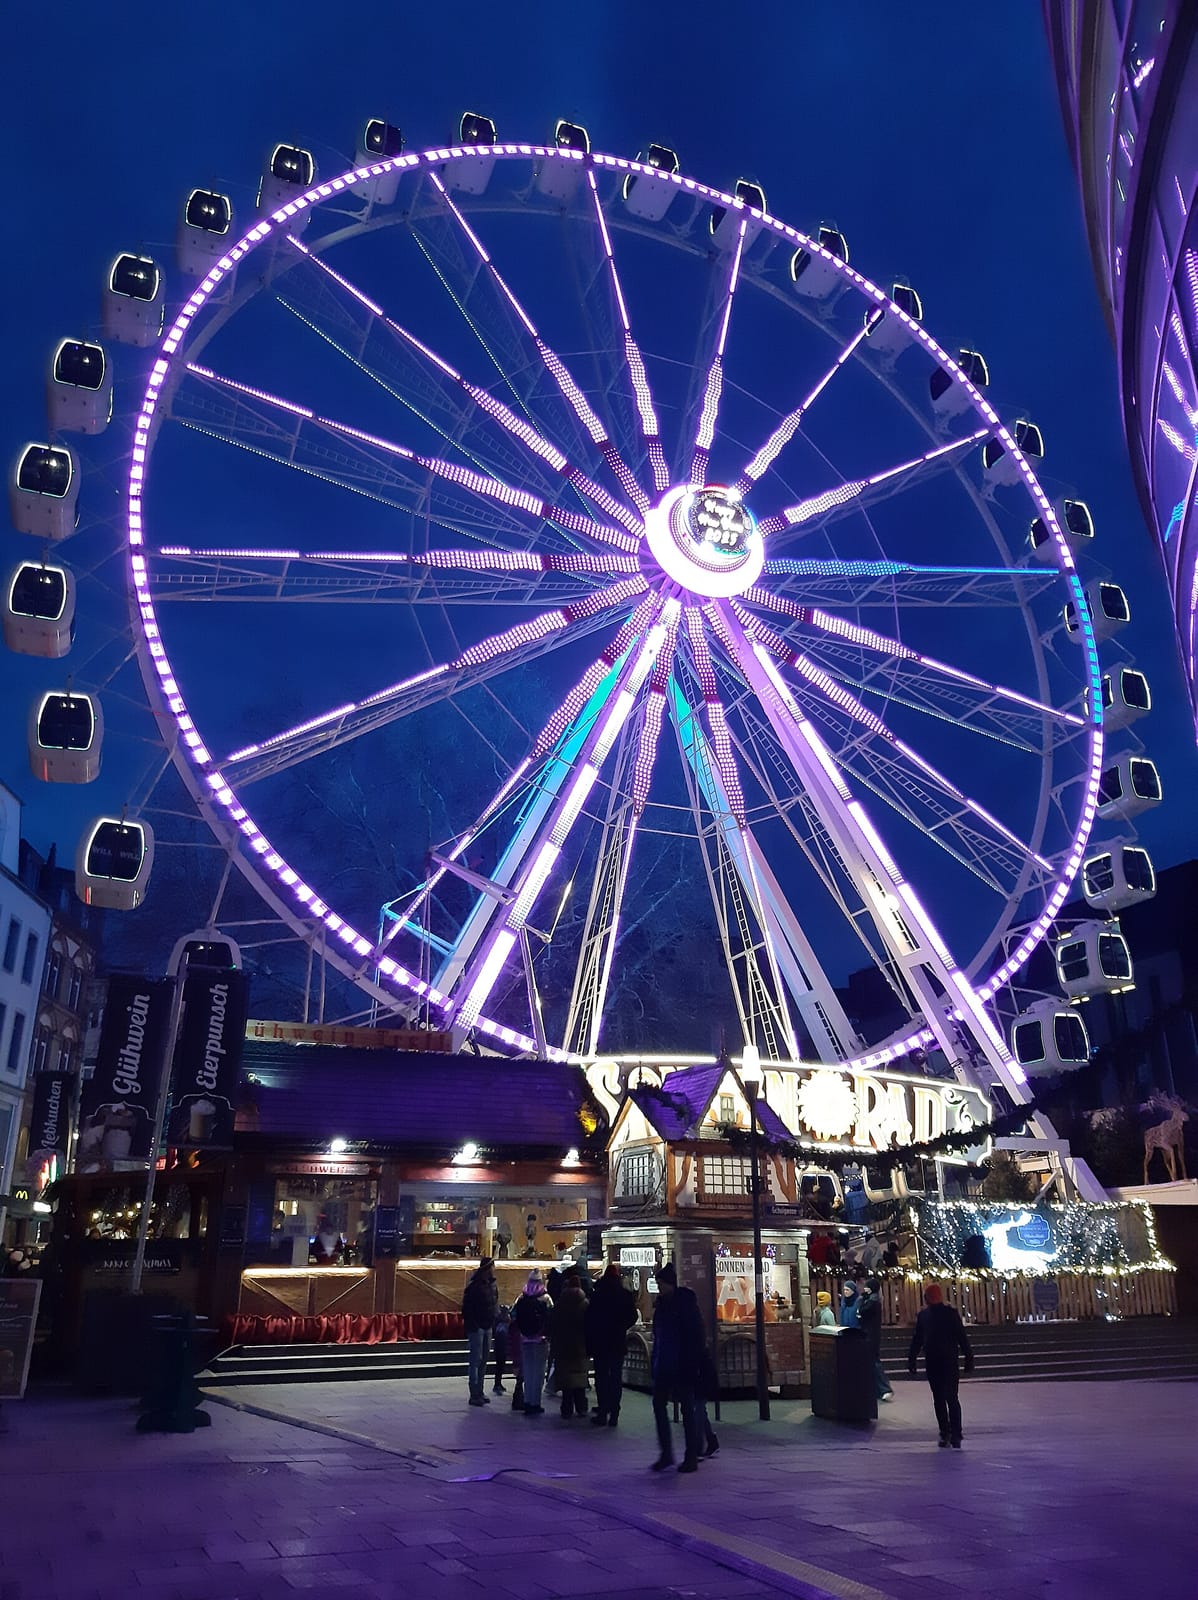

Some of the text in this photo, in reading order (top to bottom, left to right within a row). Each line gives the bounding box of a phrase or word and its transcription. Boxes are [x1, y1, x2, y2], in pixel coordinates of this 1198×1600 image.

[112, 994, 151, 1095] Glühwein
[196, 983, 229, 1090] Eierpunsch
[41, 1080, 63, 1150] Lebkuchen
[853, 1074, 948, 1152] RAD
[621, 1250, 654, 1265] SONNEN RAD
[716, 1260, 745, 1273] SONNEN
